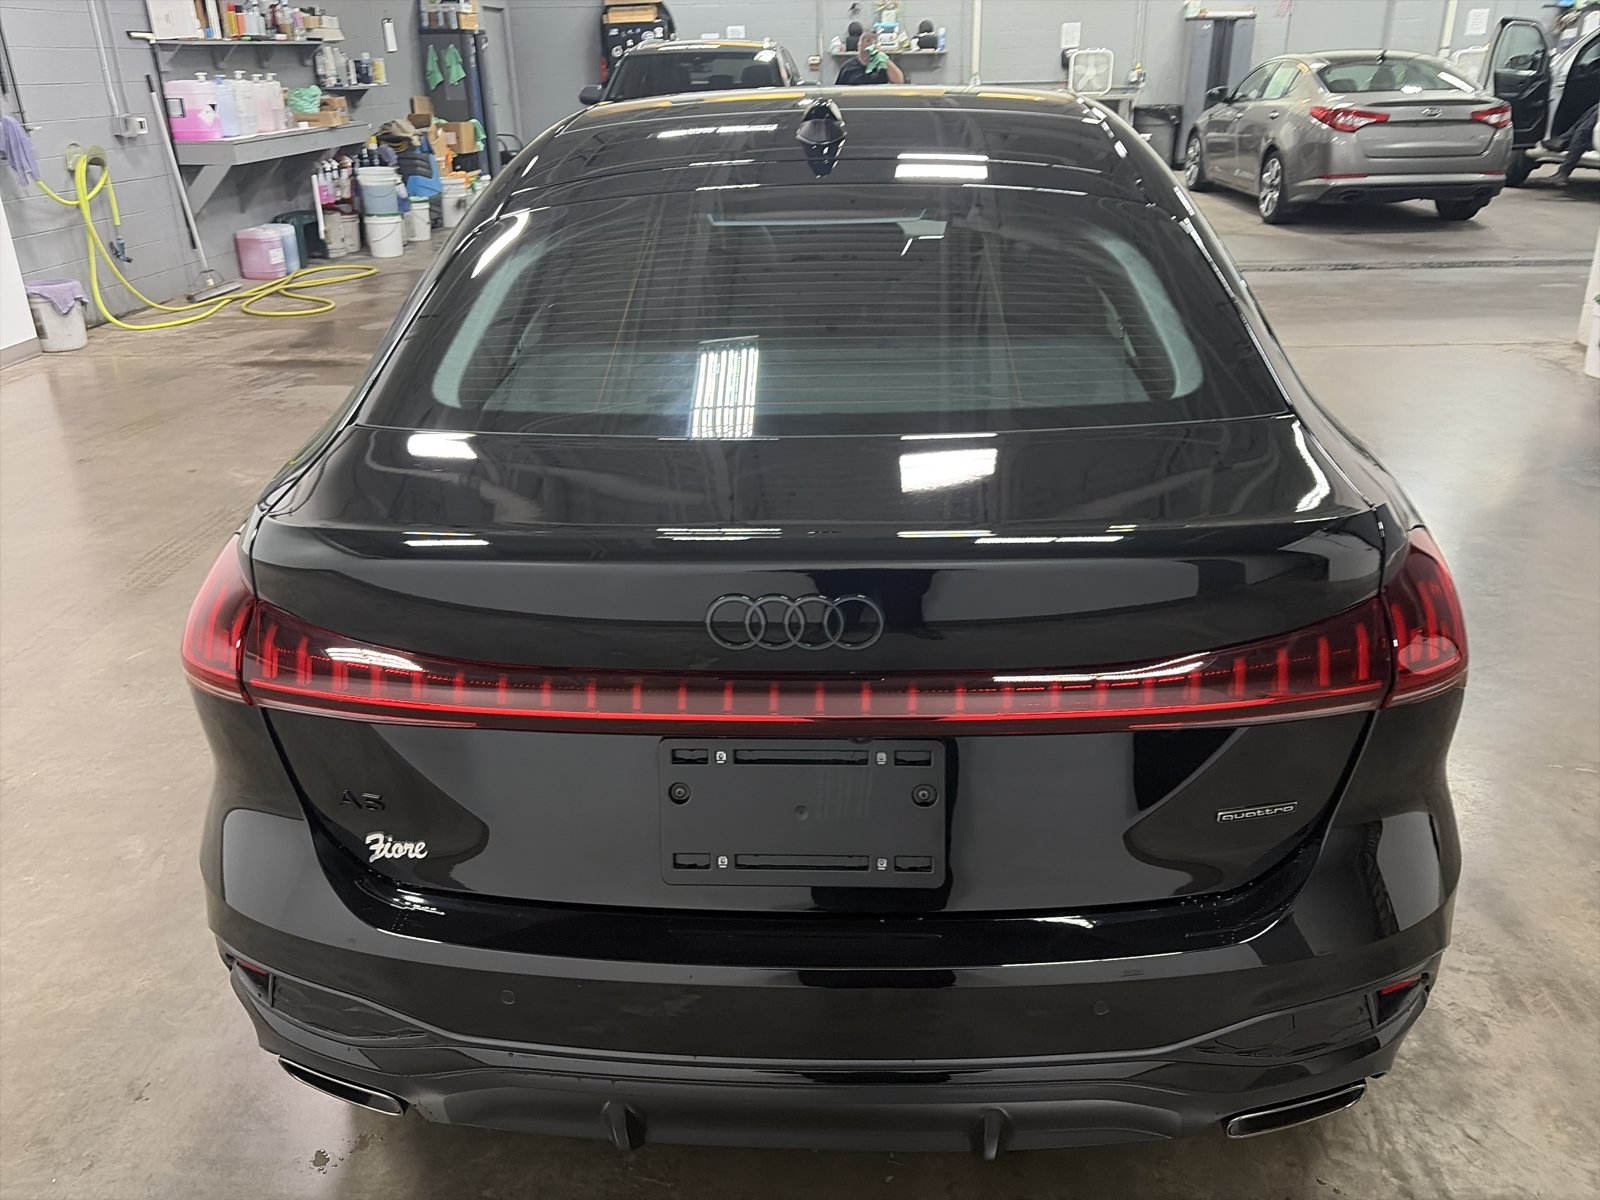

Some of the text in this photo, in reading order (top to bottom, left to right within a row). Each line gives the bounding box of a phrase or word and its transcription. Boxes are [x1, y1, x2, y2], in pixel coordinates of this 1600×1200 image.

[338, 789, 385, 811] A5
[1221, 804, 1295, 821] quattro
[365, 832, 428, 863] Fiore
